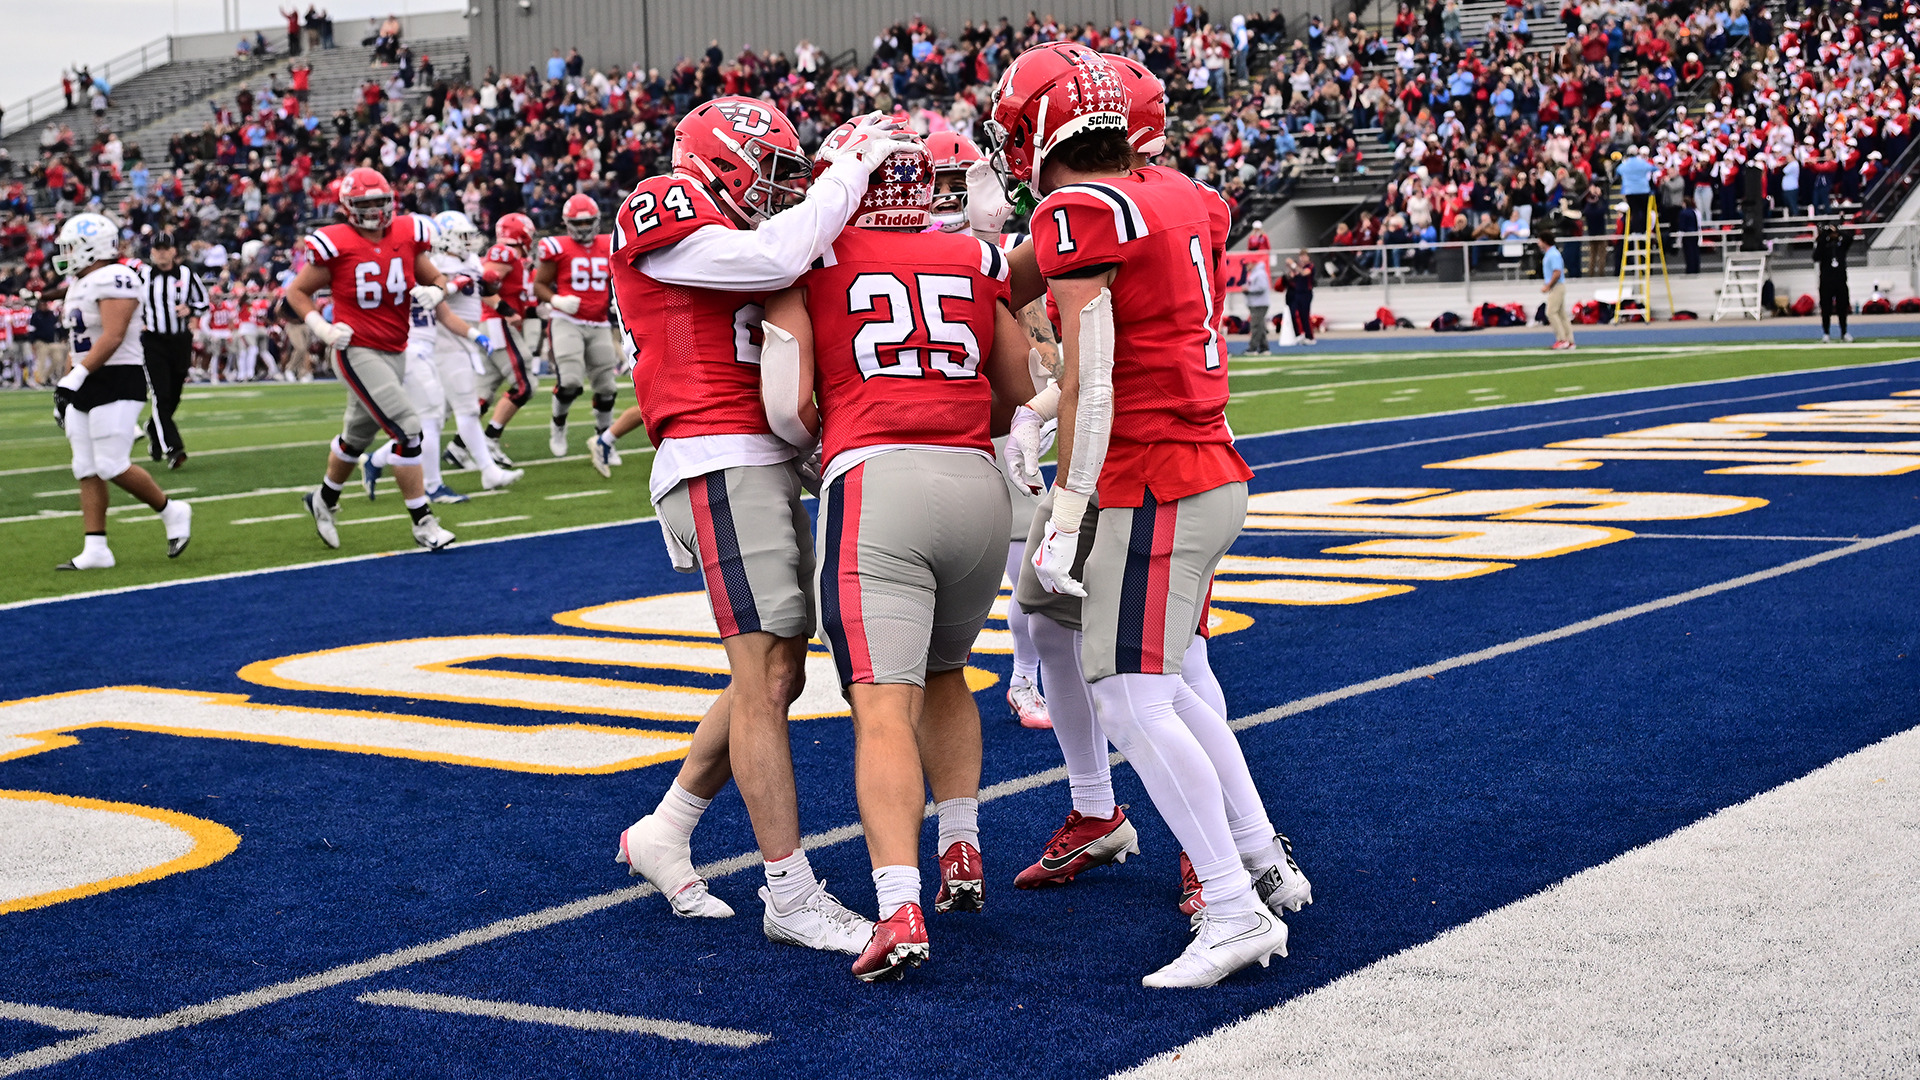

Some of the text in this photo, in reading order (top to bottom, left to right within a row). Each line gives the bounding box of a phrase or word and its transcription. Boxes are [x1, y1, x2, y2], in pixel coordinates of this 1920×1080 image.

[76, 219, 98, 237] PC
[628, 185, 698, 237] 24
[874, 213, 926, 226] Riddell
[1052, 206, 1078, 256] 1
[489, 246, 511, 263] 54
[570, 256, 610, 292] 65
[114, 274, 134, 289] 52
[354, 256, 408, 310] 64
[1189, 234, 1221, 371] 1
[846, 272, 981, 383] 25
